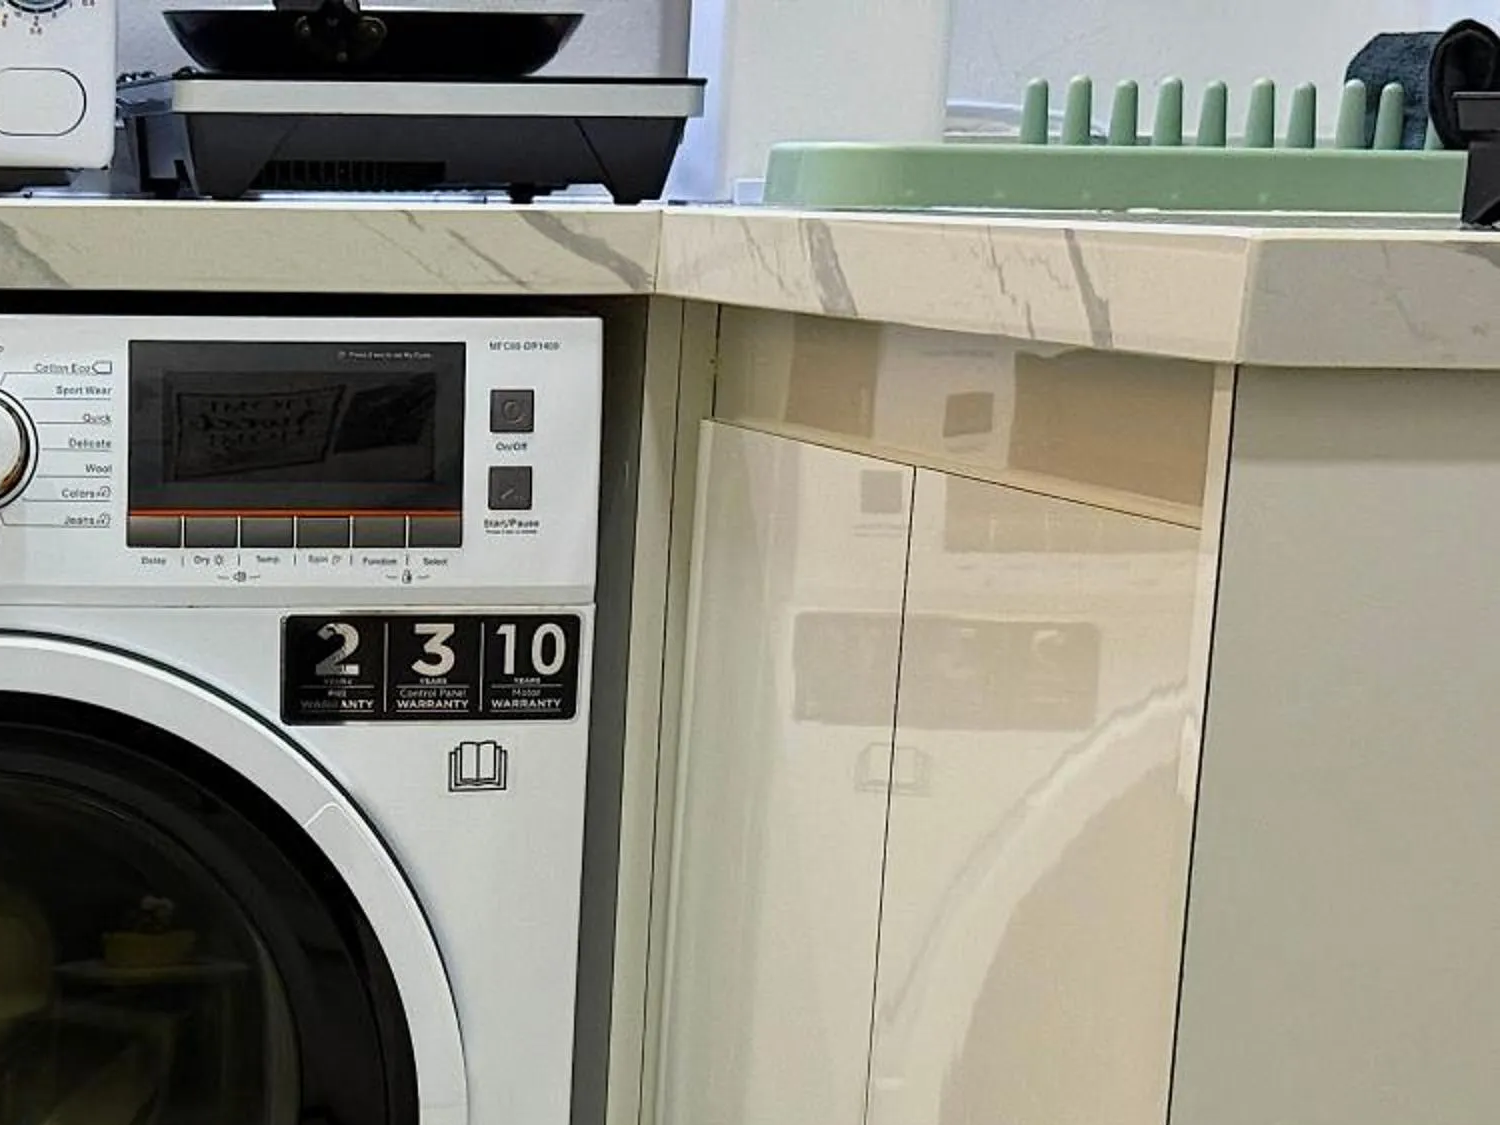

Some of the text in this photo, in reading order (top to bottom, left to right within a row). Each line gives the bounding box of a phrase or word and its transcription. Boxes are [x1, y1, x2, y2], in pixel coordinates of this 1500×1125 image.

[36, 363, 69, 373] Cotton
[56, 386, 83, 397] Sport
[82, 413, 112, 425] Quick
[68, 438, 112, 449] Delicate
[495, 441, 528, 451] On/Off
[85, 464, 113, 474] Wool
[61, 488, 95, 498] Colors
[483, 518, 539, 529] Start/Pause
[314, 622, 360, 677] 2
[411, 622, 456, 678] 3
[496, 622, 567, 677] 10
[419, 677, 448, 685] YEARS
[513, 677, 542, 685] YEARS
[399, 688, 468, 698] Control Panel
[511, 688, 542, 698] Motor
[395, 699, 470, 709] WARRANTY
[491, 699, 562, 709] WARRANTY
